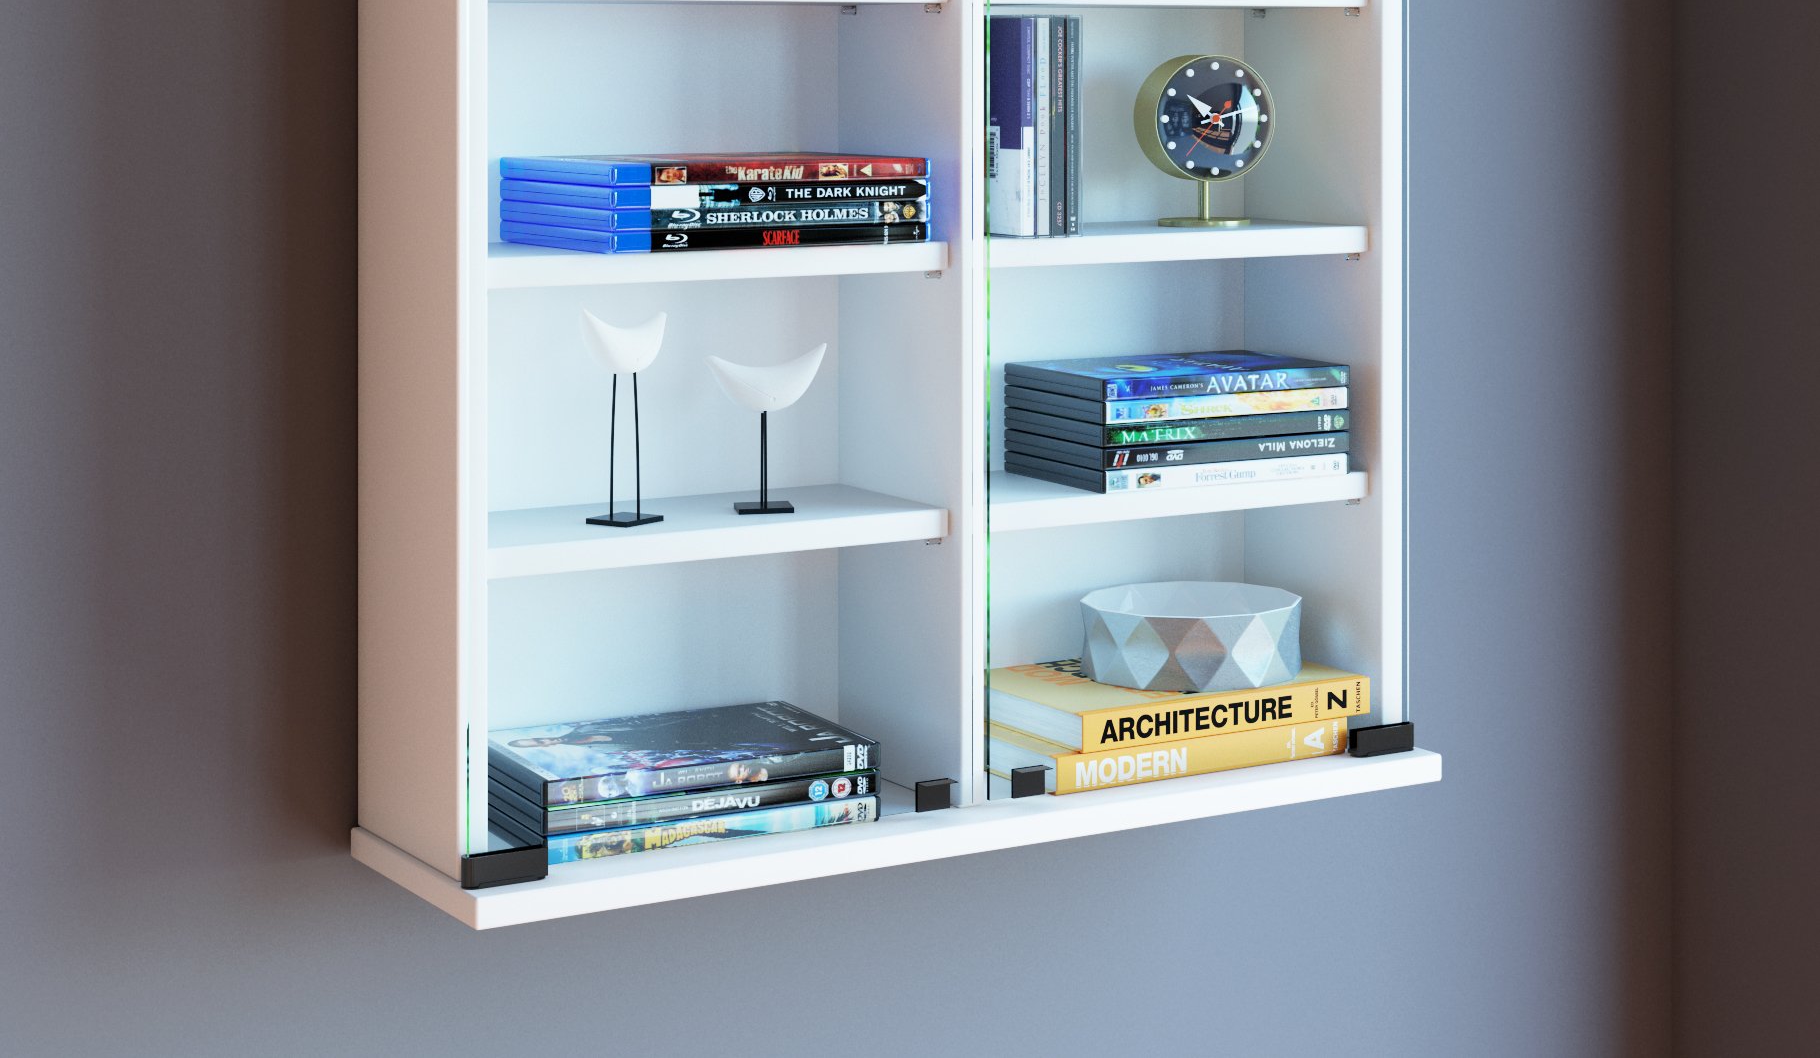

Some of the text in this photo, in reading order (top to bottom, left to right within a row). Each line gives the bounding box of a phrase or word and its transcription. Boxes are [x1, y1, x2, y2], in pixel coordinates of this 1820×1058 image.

[726, 166, 804, 181] the Karate Kid
[786, 186, 906, 199] THE DARK KNIGHT
[706, 207, 868, 224] SHERLOCK HOLMES
[763, 230, 800, 246] SCARFACE
[1170, 382, 1204, 390] CAMERON'S
[1206, 372, 1290, 394] AVATAR
[1122, 426, 1197, 444] MATRIX
[1258, 438, 1336, 452] ZIELONA MILA
[1196, 470, 1228, 482] Forrest
[1229, 469, 1256, 480] Gump
[1327, 690, 1348, 710] Z
[1100, 695, 1292, 744] ARCHITECTURE
[1304, 727, 1324, 749] A
[1075, 748, 1188, 788] MODERN
[644, 820, 726, 850] MADAGASCAR
